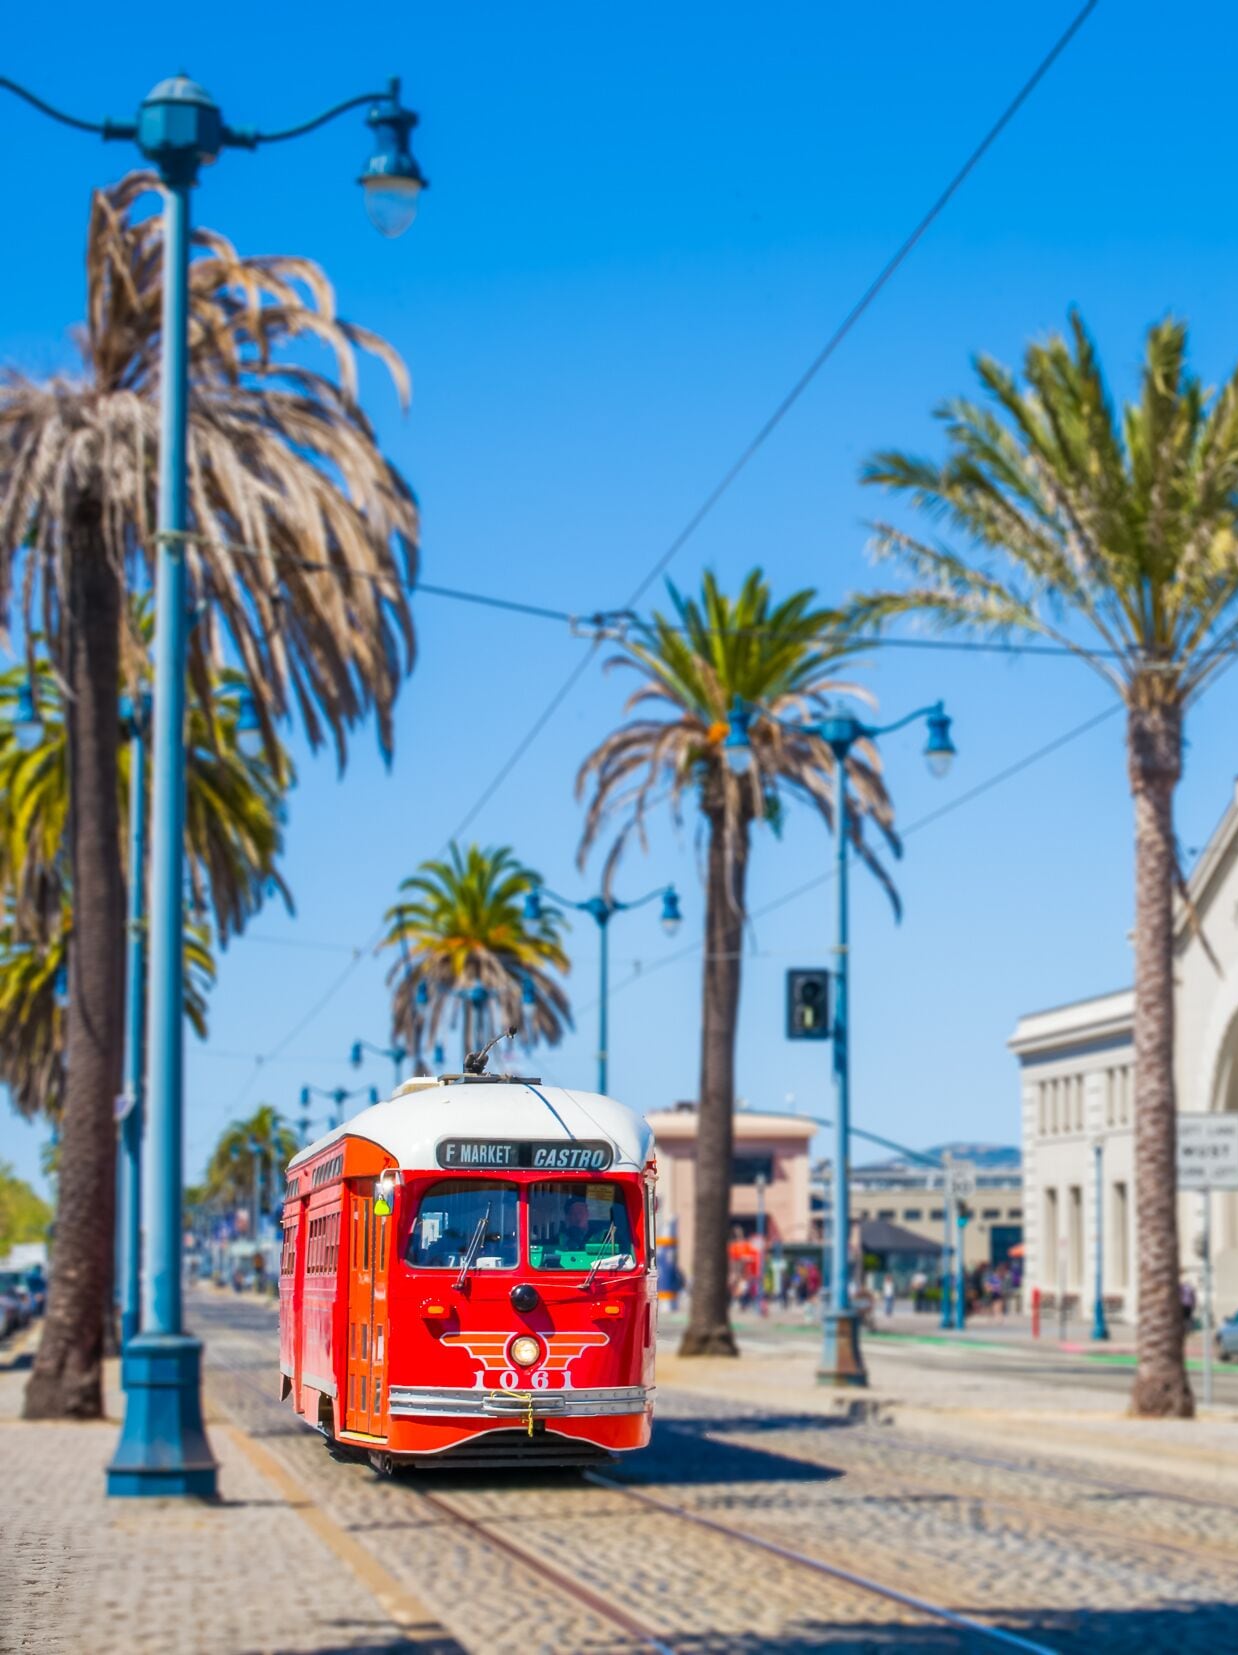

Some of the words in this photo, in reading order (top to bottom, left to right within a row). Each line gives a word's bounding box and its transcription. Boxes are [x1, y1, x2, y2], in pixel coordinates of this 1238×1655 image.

[446, 1144, 456, 1162] F
[461, 1145, 511, 1164] MARKET
[534, 1149, 604, 1168] CASTRO
[472, 1371, 576, 1389] 1061
